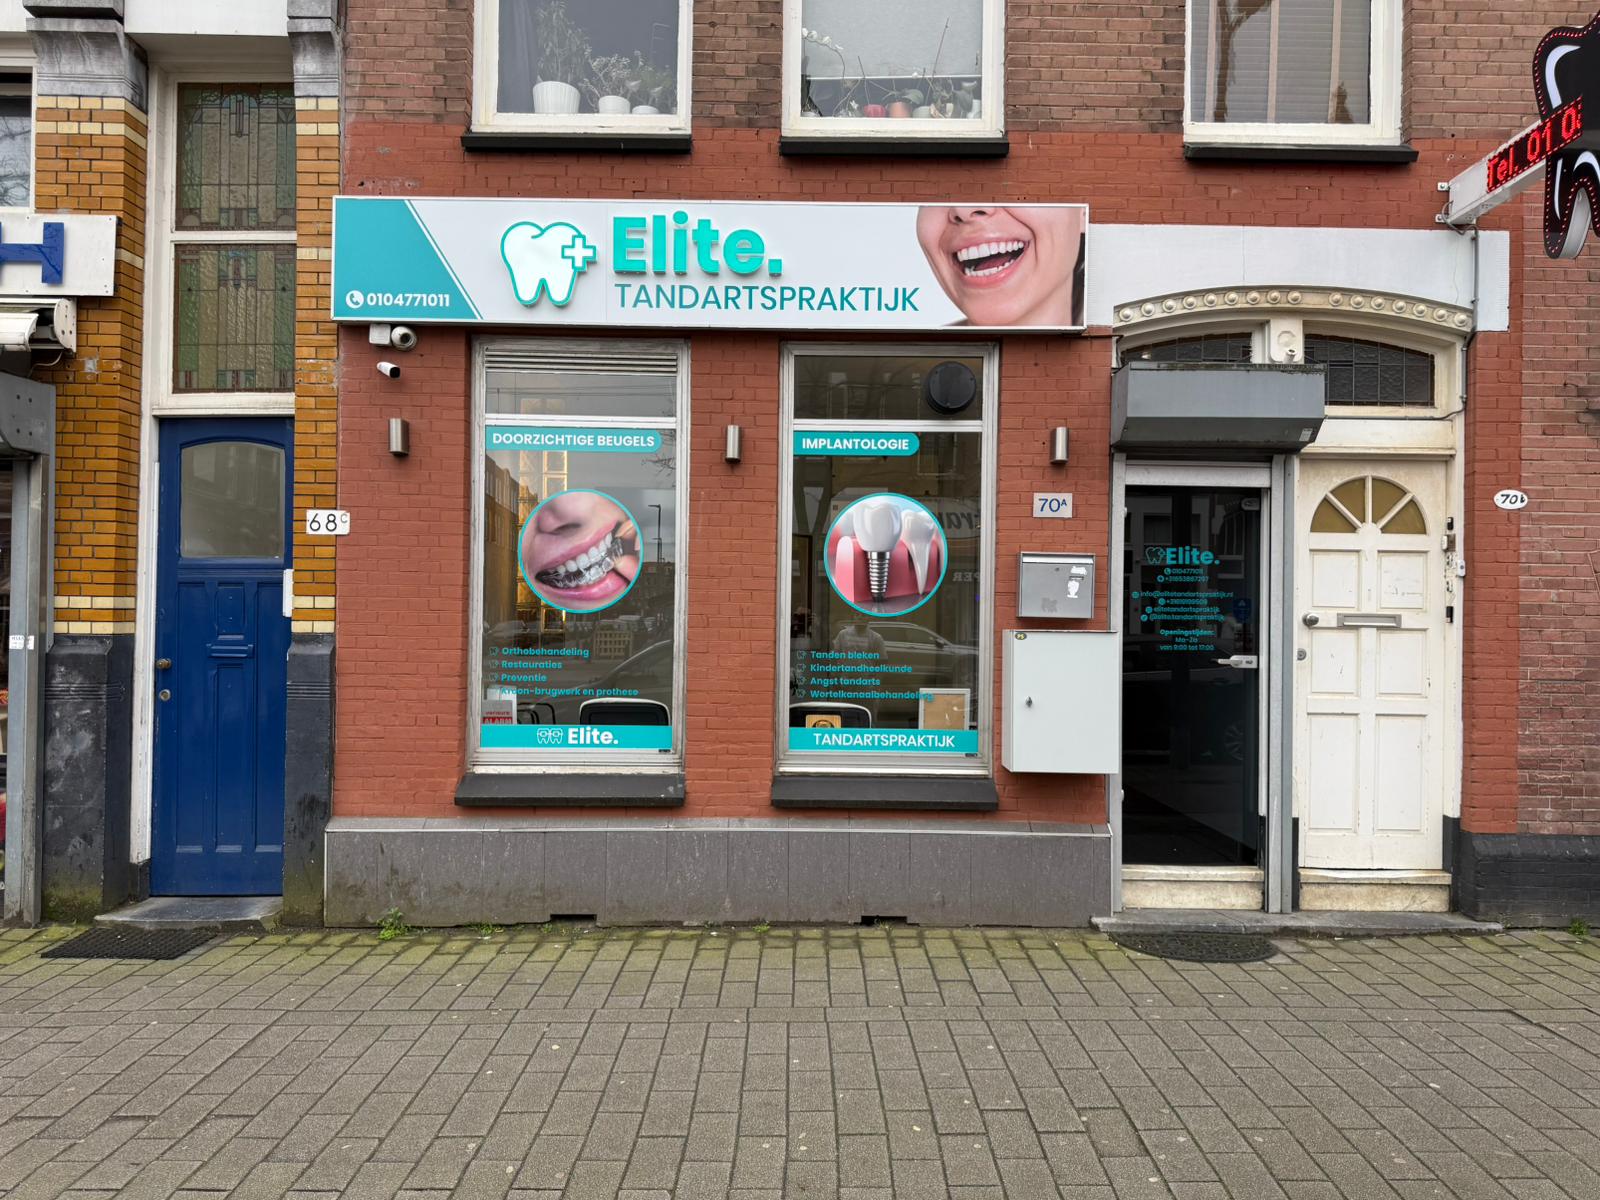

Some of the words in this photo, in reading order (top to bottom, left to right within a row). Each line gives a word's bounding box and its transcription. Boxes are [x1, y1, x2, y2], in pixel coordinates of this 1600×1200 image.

[1487, 145, 1519, 188] Tel.
[612, 210, 783, 277] Elite.
[366, 292, 450, 307] 0104771011
[614, 283, 920, 312] TANDARTSPRAKTIJK
[492, 433, 595, 446] DOORZICHTIGE
[597, 434, 655, 447] BEUGELS
[802, 437, 910, 450] IMPLANTOLOGIE
[1038, 498, 1067, 512] 70A
[1166, 546, 1220, 565] Elite.
[501, 647, 590, 658] Orthobehandeling
[810, 651, 846, 660] Tanden
[847, 651, 880, 660] bleken
[501, 660, 562, 669] Restauraties
[810, 664, 913, 673] Kindertandheelkunde
[501, 673, 547, 682] Preventie
[810, 677, 839, 687] Angst
[839, 677, 881, 686] tandarts
[582, 688, 594, 696] en
[596, 687, 639, 697] prothese
[567, 726, 619, 745] Elite.
[812, 733, 956, 747] TANDARTSPRAKTIJK
